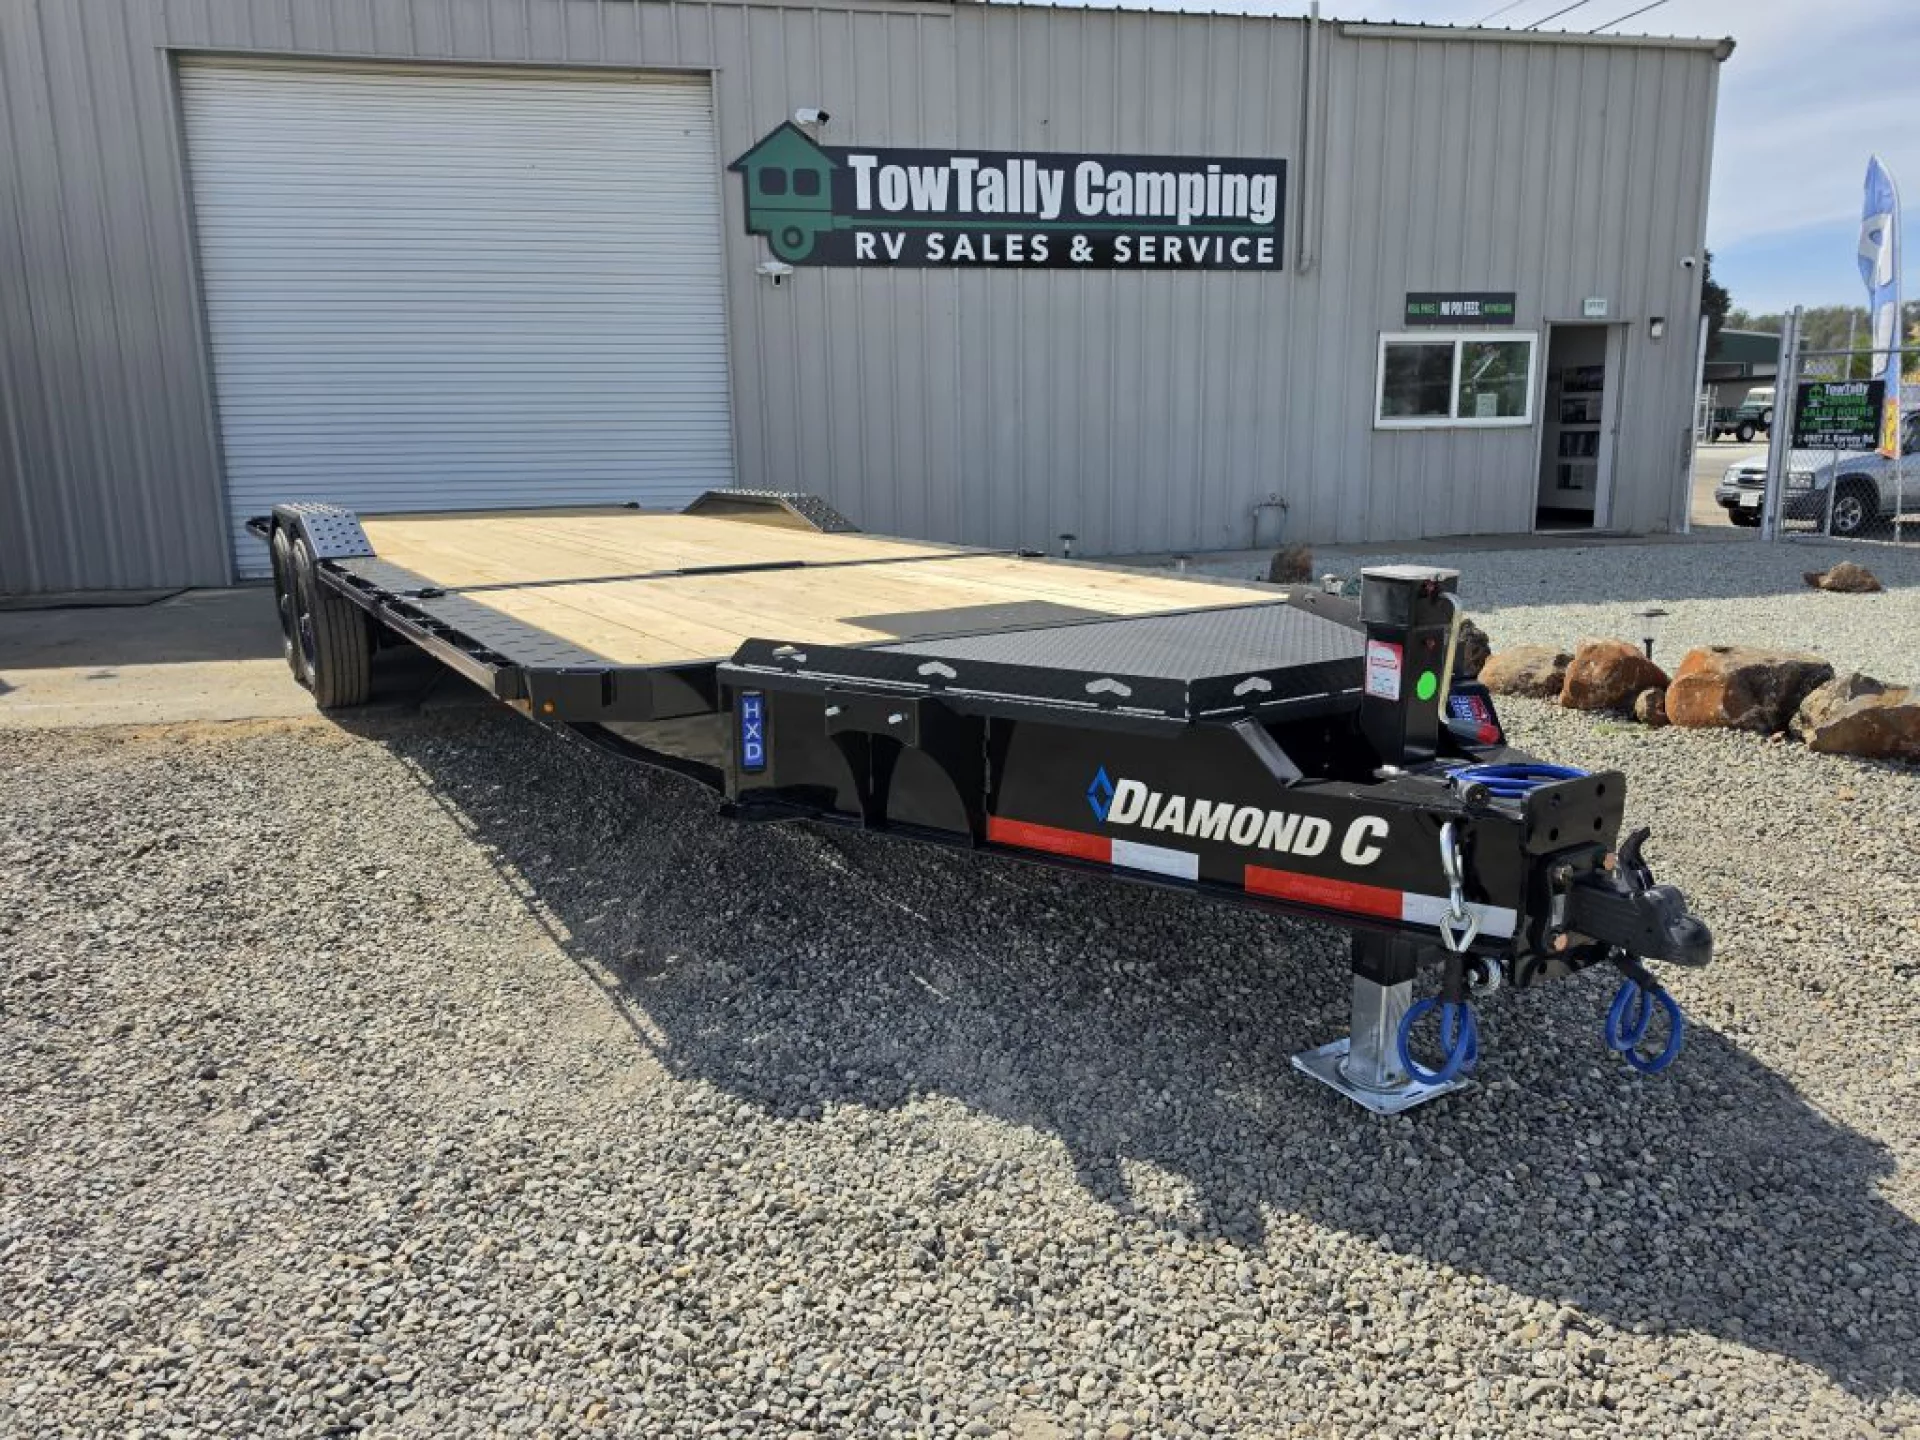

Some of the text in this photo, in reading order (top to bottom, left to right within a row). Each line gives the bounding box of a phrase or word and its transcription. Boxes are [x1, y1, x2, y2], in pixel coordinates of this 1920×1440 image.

[848, 154, 1278, 226] TowTally Camping
[855, 231, 1275, 264] RV SALES & SERVICE
[744, 702, 761, 760] HXD
[1107, 778, 1333, 856] DIAMOND
[1341, 815, 1389, 866] C
